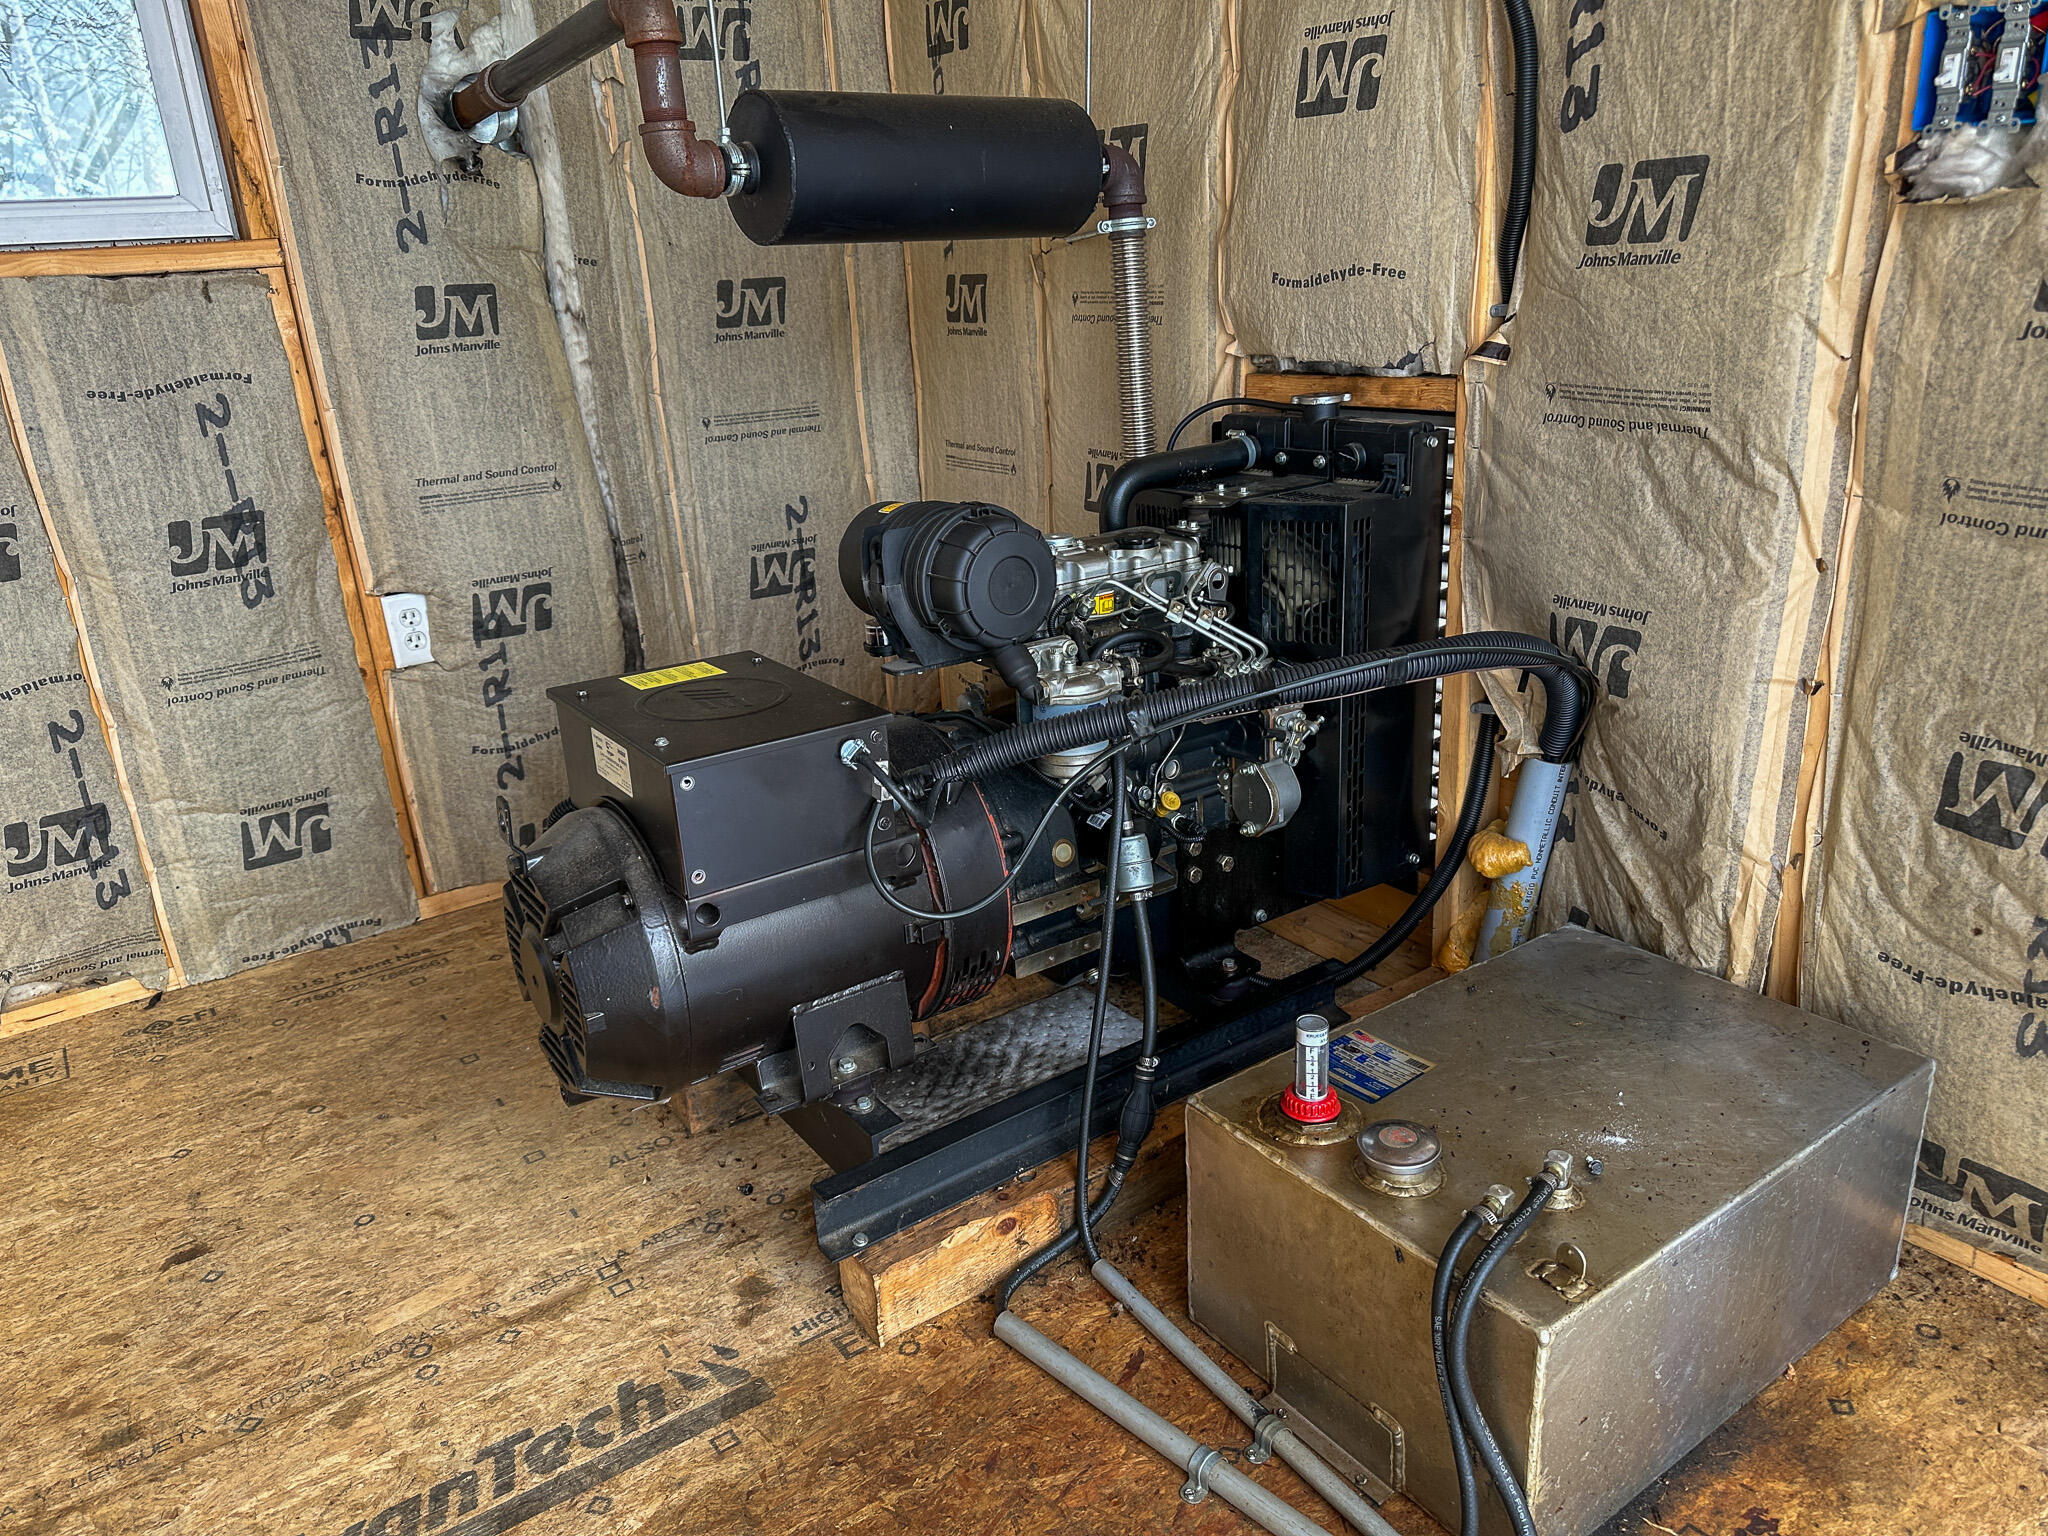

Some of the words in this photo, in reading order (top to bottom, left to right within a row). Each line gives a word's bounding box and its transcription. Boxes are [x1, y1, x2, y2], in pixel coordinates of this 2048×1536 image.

[1352, 9, 1395, 30] Johns
[1304, 21, 1352, 40] Manville
[1294, 34, 1388, 119] JM
[1585, 154, 1710, 247] JM
[1576, 251, 1616, 270] Johns
[1617, 249, 1682, 267] Manville
[1271, 262, 1407, 289] Formaldehyde-Free
[716, 277, 786, 329] JM
[946, 274, 988, 324] JM
[414, 283, 500, 341] JM
[1071, 314, 1096, 325] Control
[714, 331, 744, 343] Johns
[744, 328, 786, 341] Manville
[946, 326, 961, 336] Johns
[960, 326, 988, 337] Manville
[414, 342, 450, 357] Johns
[452, 339, 501, 353] Manville
[86, 373, 252, 402] Formaldehyde-Free
[789, 424, 822, 435] Thermal
[1542, 412, 1585, 428] Control
[1587, 415, 1626, 431] Sound
[1629, 420, 1653, 433] and
[704, 431, 739, 445] Control
[740, 428, 769, 440] Sound
[770, 427, 787, 437] and
[1657, 423, 1709, 440] Thermal
[944, 440, 966, 451] Thermal
[965, 443, 975, 451] and
[975, 443, 995, 454] Sound
[994, 445, 1017, 457] Control
[415, 473, 460, 488] Thermal
[462, 470, 483, 482] and
[484, 466, 519, 480] Sound
[520, 461, 558, 476] Control
[1939, 512, 2009, 537] Control
[167, 509, 267, 577] JM
[751, 538, 792, 552] Manville
[169, 579, 211, 595] Johns
[211, 567, 272, 587] Manville
[471, 571, 521, 588] Manville
[521, 566, 553, 581] Johns
[750, 547, 817, 600] JM
[471, 581, 553, 642] JM
[1552, 594, 1608, 616] Manville
[1608, 605, 1652, 625] Johns
[249, 675, 275, 690] and
[273, 666, 327, 683] Thermal
[215, 681, 255, 695] Sound
[167, 690, 215, 707] Control
[1959, 731, 2048, 769] Manville
[293, 787, 331, 806] Johns
[1547, 785, 1561, 815] CONDUIT
[240, 798, 294, 818] Manville
[3, 802, 113, 878] JM
[240, 803, 333, 871] JM
[1535, 818, 1553, 864] NONMETALLIC
[1531, 866, 1540, 880] PVC
[7, 876, 51, 894] Johns
[1524, 882, 1536, 905] RIGID
[55, 962, 98, 979] Sound
[99, 955, 124, 968] and
[333, 958, 393, 980] Patent
[175, 1007, 218, 1026] SFI
[1489, 1231, 1509, 1249] Fuel
[1955, 1211, 2043, 1256] Manville
[1433, 1315, 1443, 1331] SAE
[1496, 1455, 1509, 1475] Not
[1505, 1476, 1517, 1496] For
[1514, 1497, 1529, 1524] Fuel
